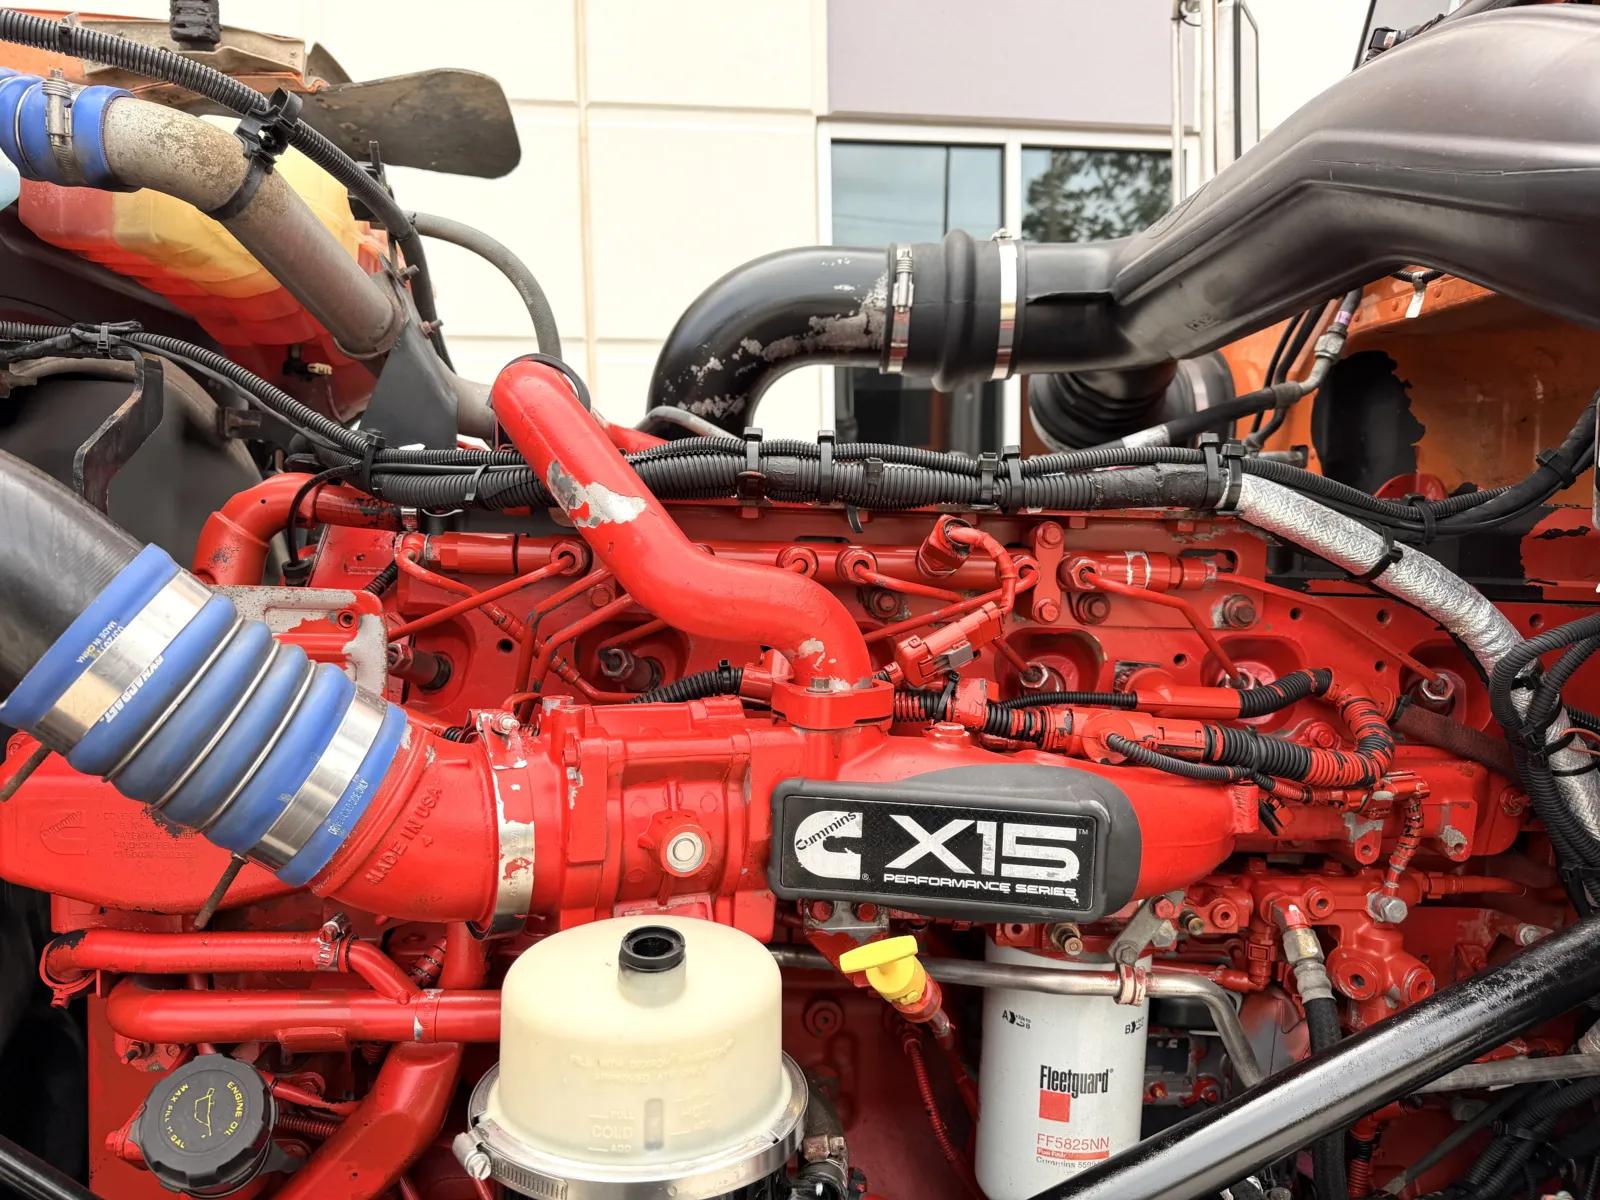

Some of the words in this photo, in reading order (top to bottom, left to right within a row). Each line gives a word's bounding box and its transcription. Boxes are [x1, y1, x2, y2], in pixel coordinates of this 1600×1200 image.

[98, 619, 117, 639] MADE
[365, 840, 408, 885] MADE
[400, 818, 424, 841] IN
[415, 785, 442, 819] USA
[884, 814, 1080, 882] X15
[884, 873, 1011, 893] PERFORMANCE
[1015, 884, 1078, 900] SERIES
[1040, 1065, 1109, 1099] Fleetguard
[170, 1083, 189, 1103] MAX
[226, 1080, 244, 1118] ENGINE
[224, 1121, 239, 1137] OIL
[591, 1123, 633, 1140] COLD
[170, 1134, 185, 1149] GAL
[1037, 1133, 1110, 1151] FF5825NN
